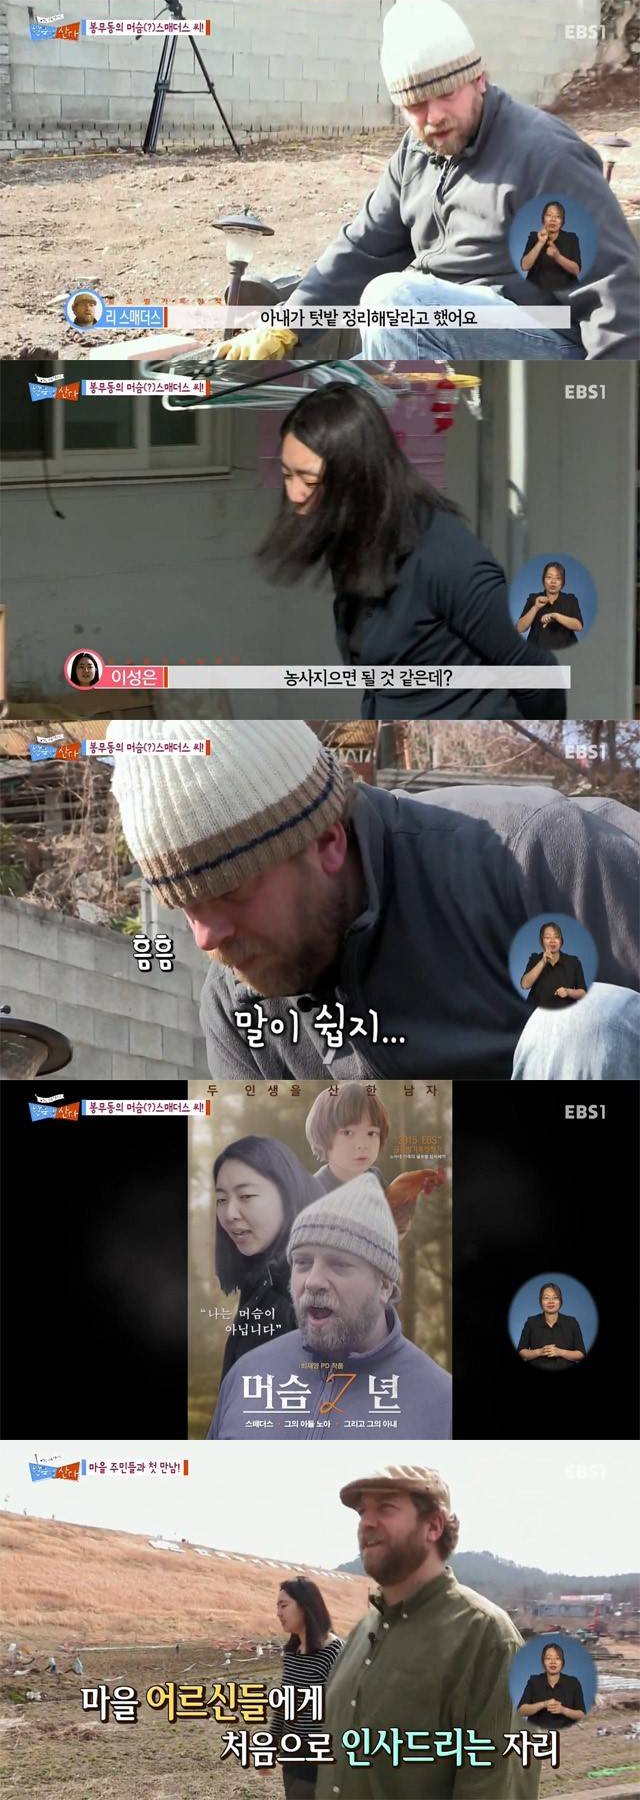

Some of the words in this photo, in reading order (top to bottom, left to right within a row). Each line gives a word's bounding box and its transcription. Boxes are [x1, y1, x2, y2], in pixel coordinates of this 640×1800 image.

[207, 1085, 219, 1096] 두
[245, 1084, 302, 1097] 인생을
[328, 1084, 340, 1096] 산
[366, 1084, 378, 1097] 한
[404, 1084, 438, 1097] 남자
[239, 1307, 276, 1320] 머슴이
[224, 1322, 282, 1338] 아닙니다”
[242, 1374, 312, 1410] 머슴
[368, 1374, 401, 1412] 년
[284, 1420, 300, 1428] 그의
[301, 1420, 314, 1428] 아들
[316, 1420, 331, 1428] 노아
[344, 1420, 364, 1428] 그리고
[366, 1420, 382, 1428] 그의
[383, 1420, 398, 1428] 아내
